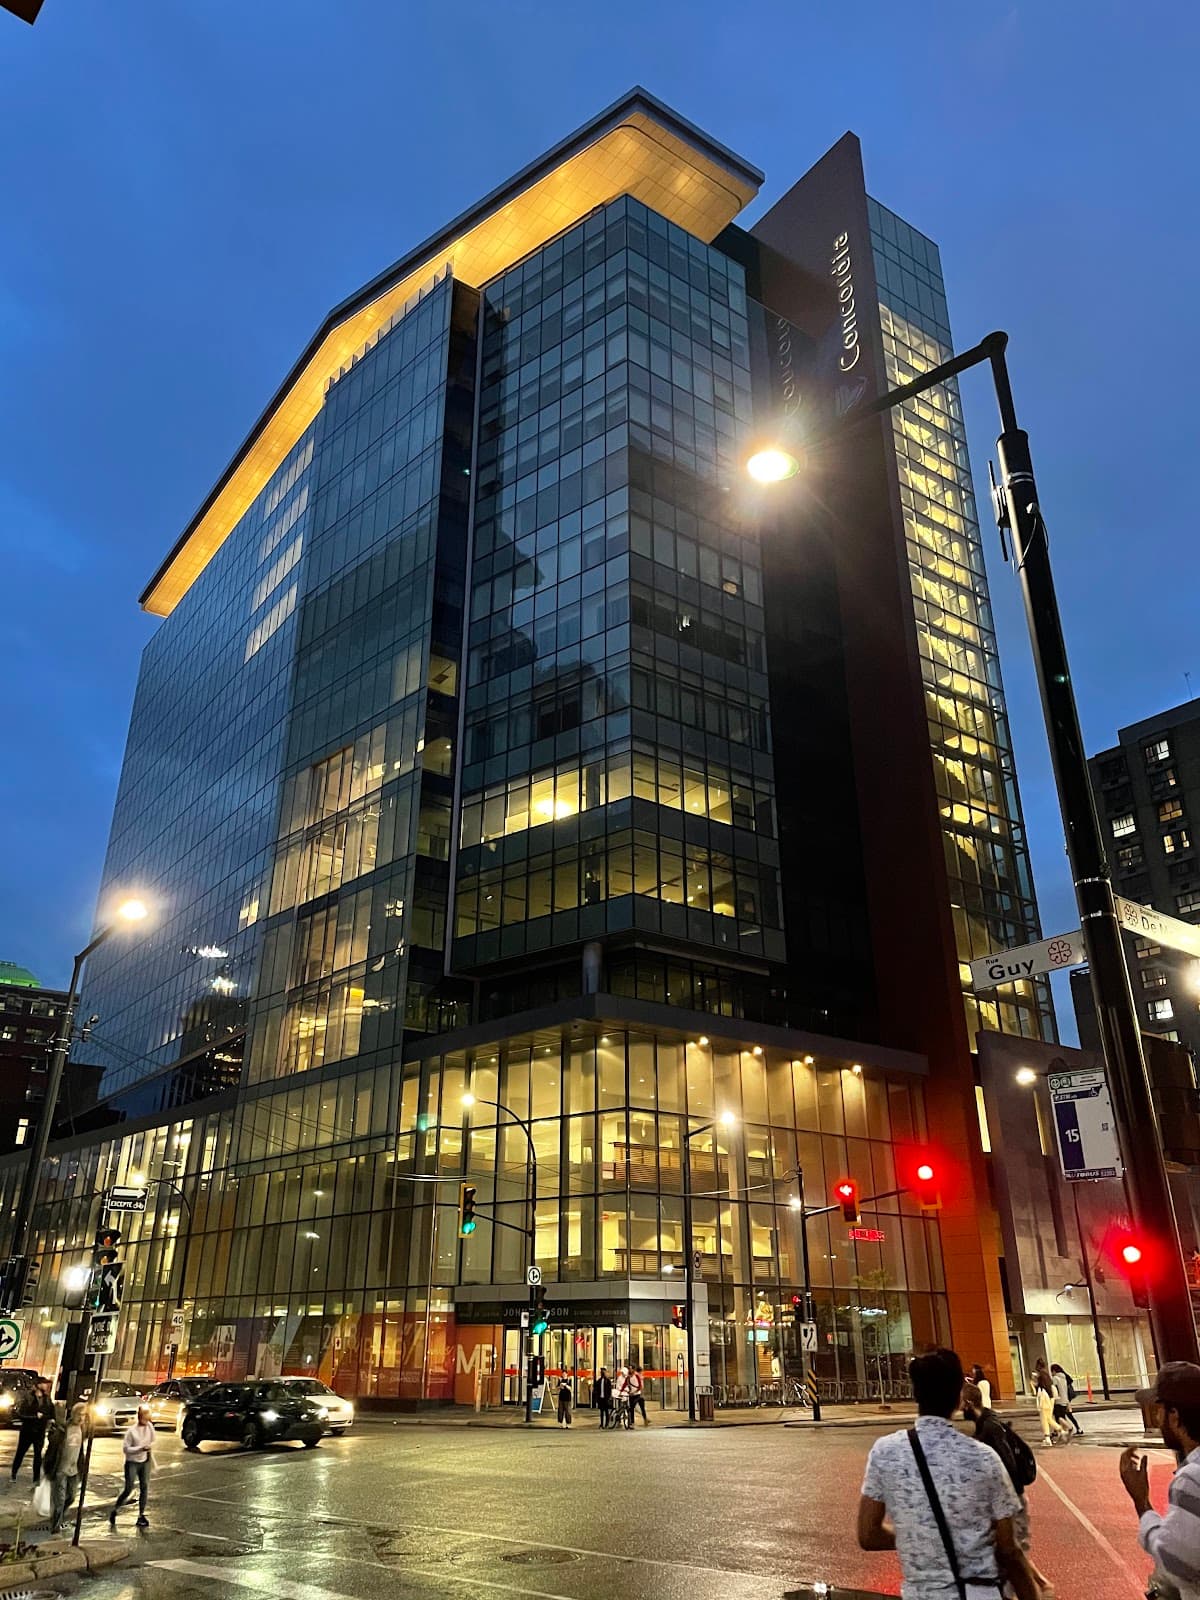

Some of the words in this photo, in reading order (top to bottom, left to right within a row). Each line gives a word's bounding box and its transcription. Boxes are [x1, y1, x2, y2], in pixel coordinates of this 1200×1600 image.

[831, 231, 860, 371] Concordia
[988, 959, 1034, 980] Guy
[1065, 1128, 1080, 1143] 15
[503, 1307, 527, 1317] JOH
[173, 1316, 183, 1325] 40
